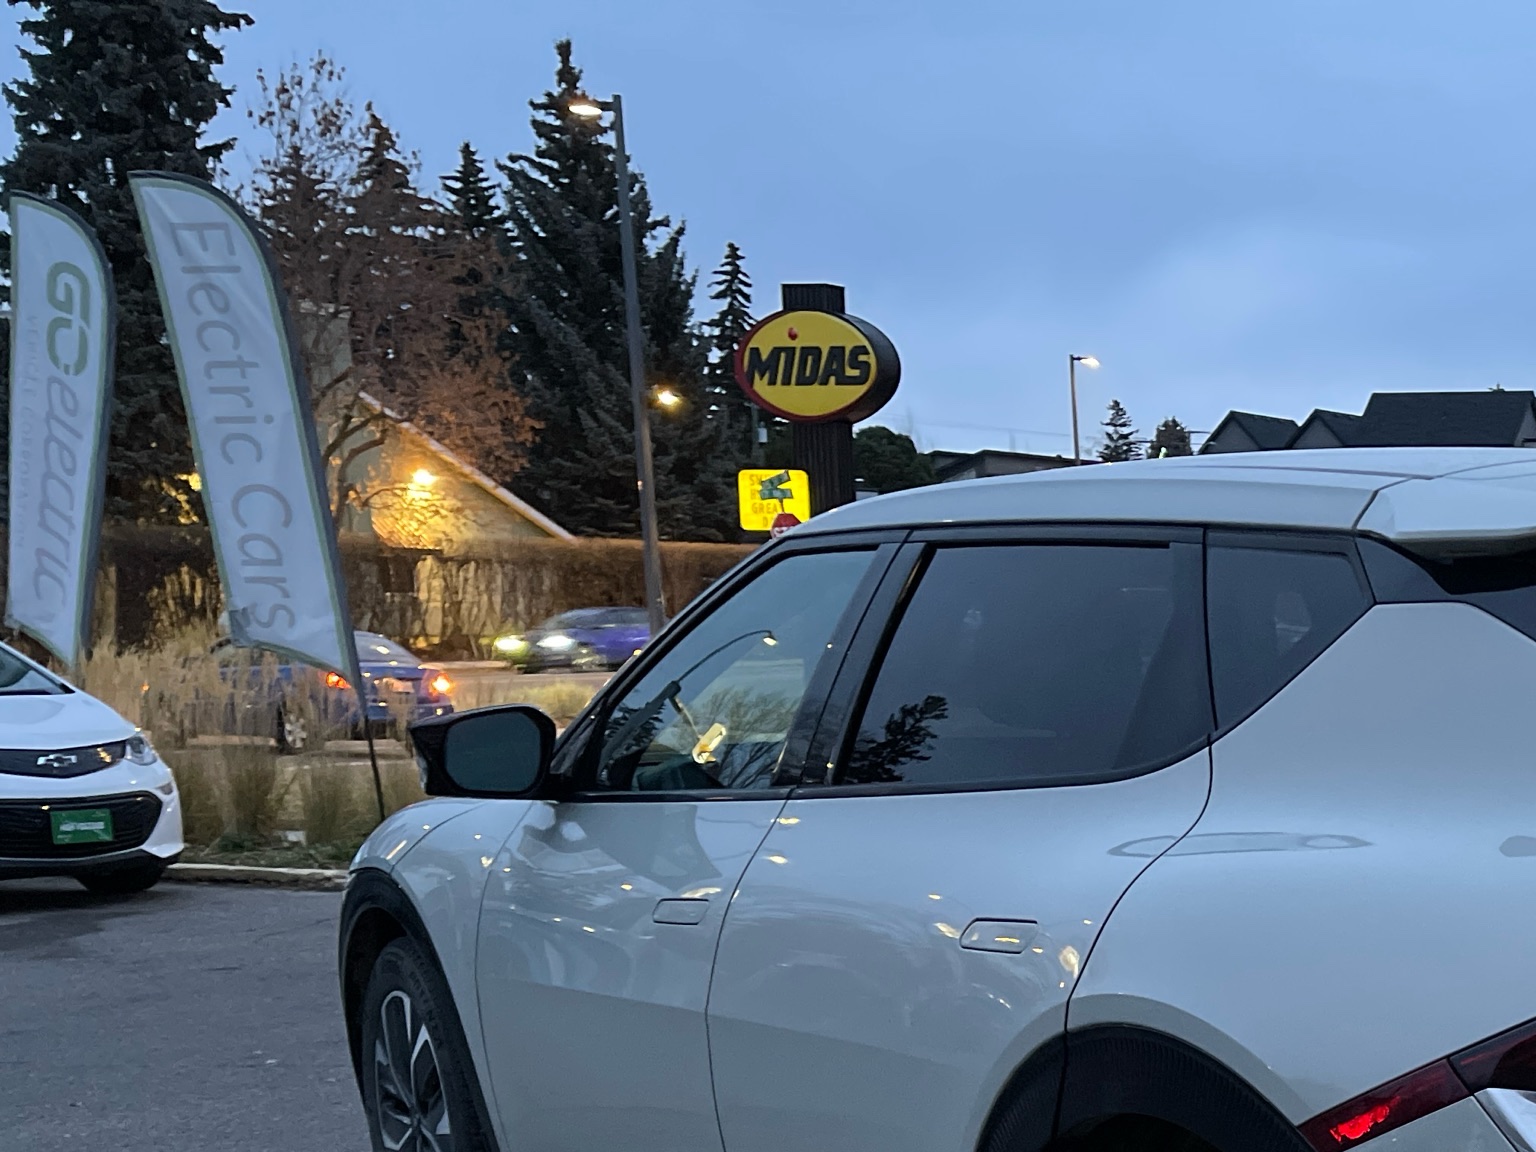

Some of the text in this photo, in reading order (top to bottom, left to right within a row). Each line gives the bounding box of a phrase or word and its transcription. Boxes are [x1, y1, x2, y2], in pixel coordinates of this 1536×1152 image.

[170, 221, 295, 629] Electric Cars
[749, 344, 871, 390] MIDAS
